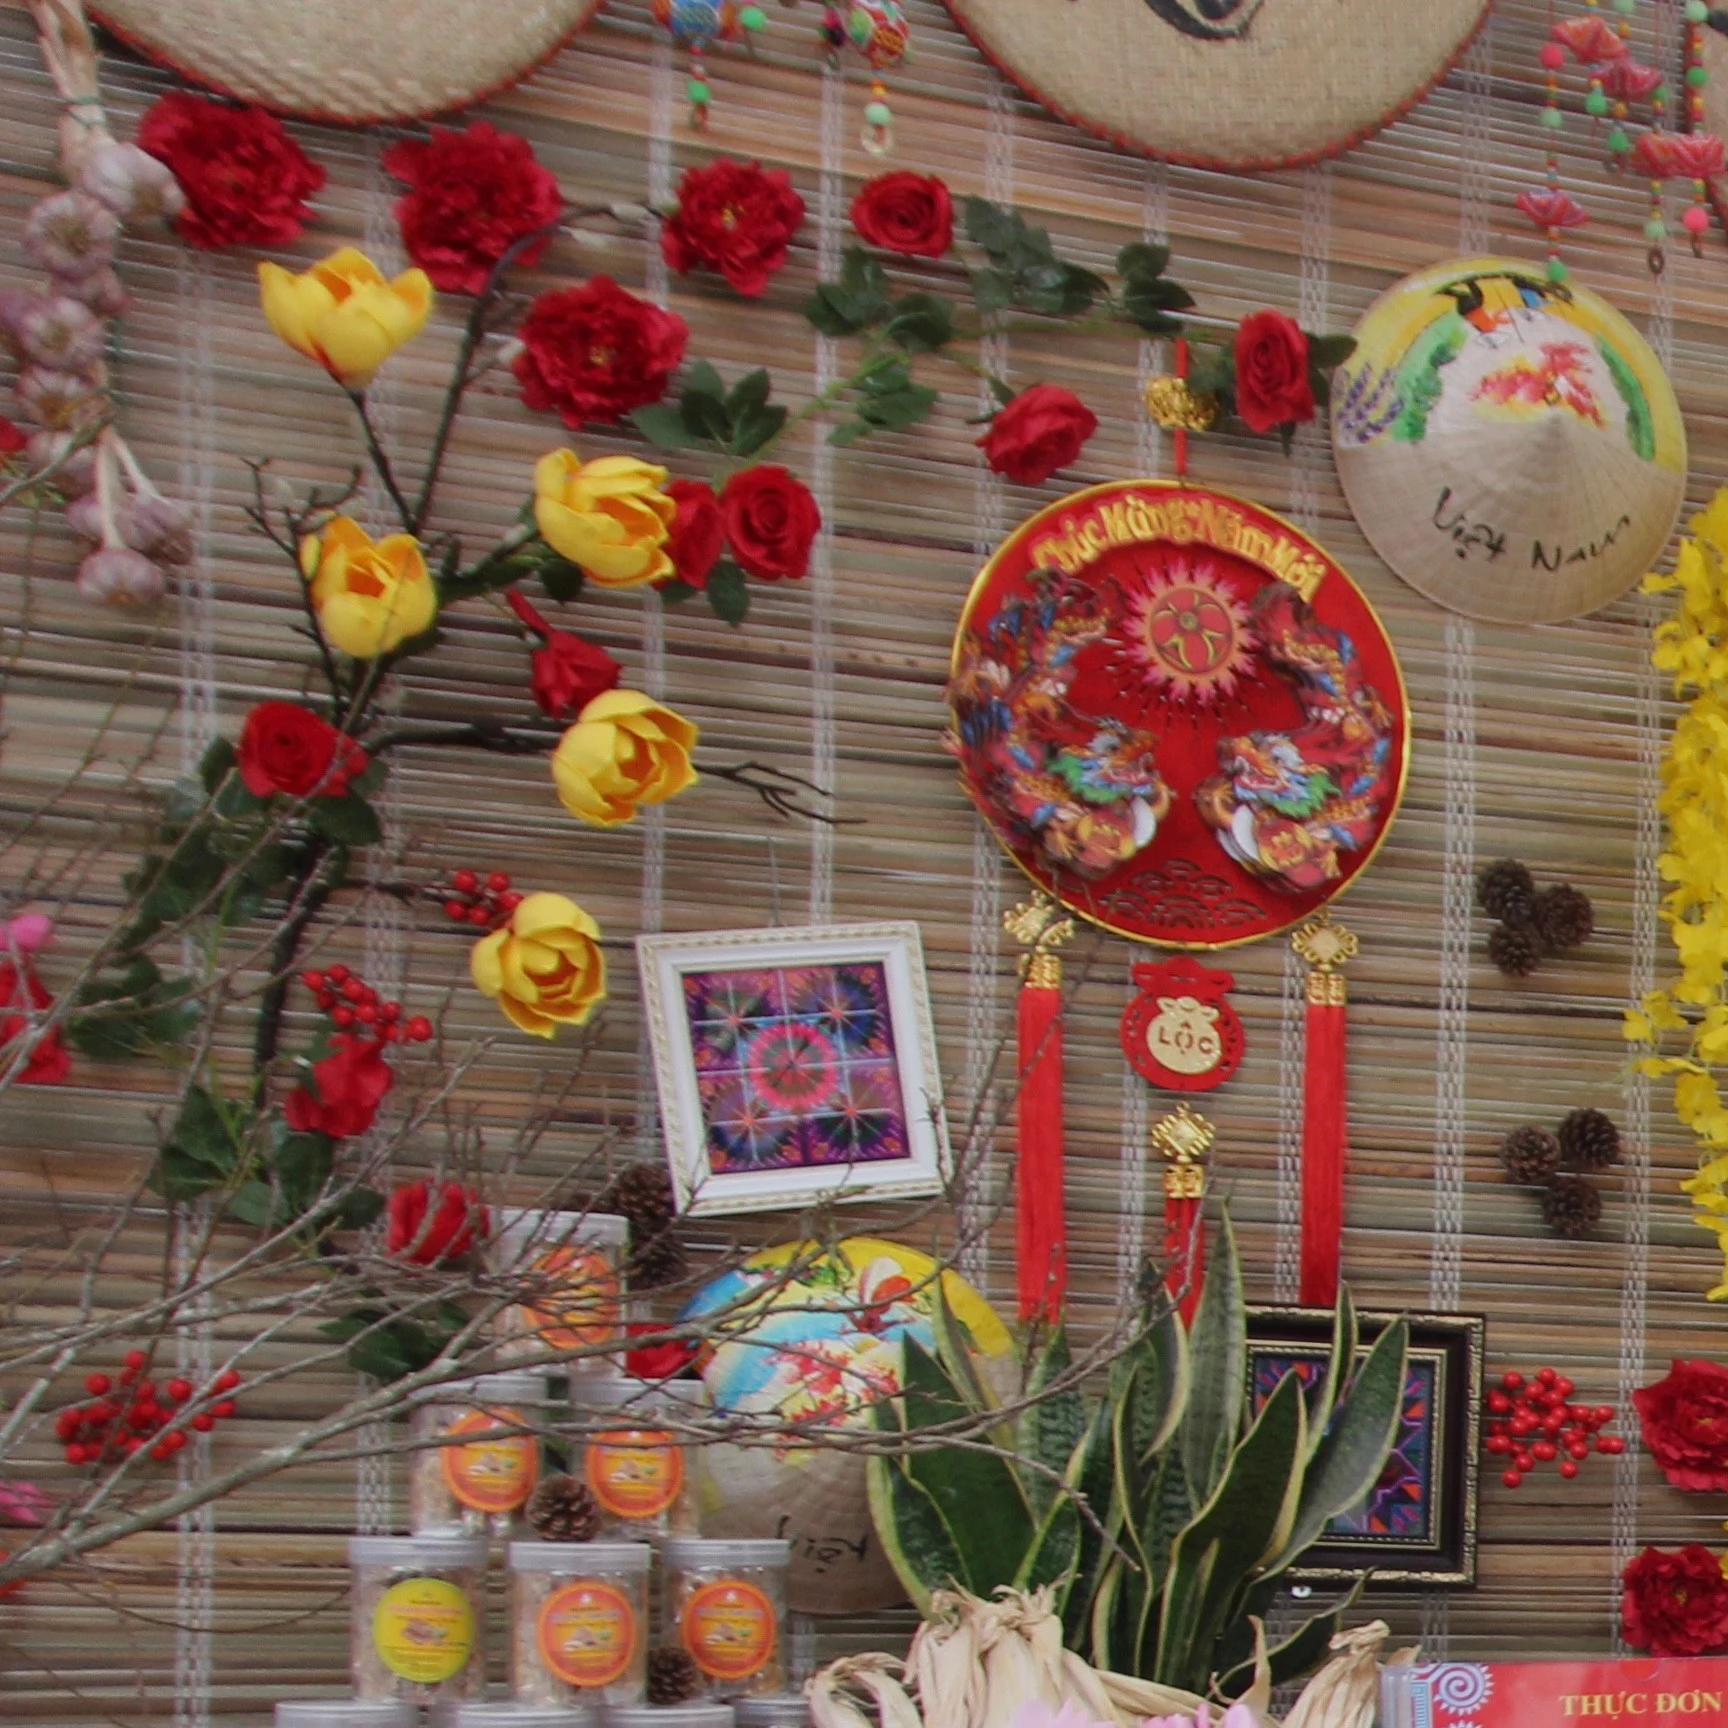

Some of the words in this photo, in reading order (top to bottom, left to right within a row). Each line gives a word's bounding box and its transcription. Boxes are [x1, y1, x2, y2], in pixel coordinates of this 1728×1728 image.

[1432, 485, 1507, 562] Việt
[1158, 1020, 1213, 1055] LỘC
[1559, 1690, 1648, 1720] THỰC
[1654, 1689, 1723, 1713] ĐƠN
